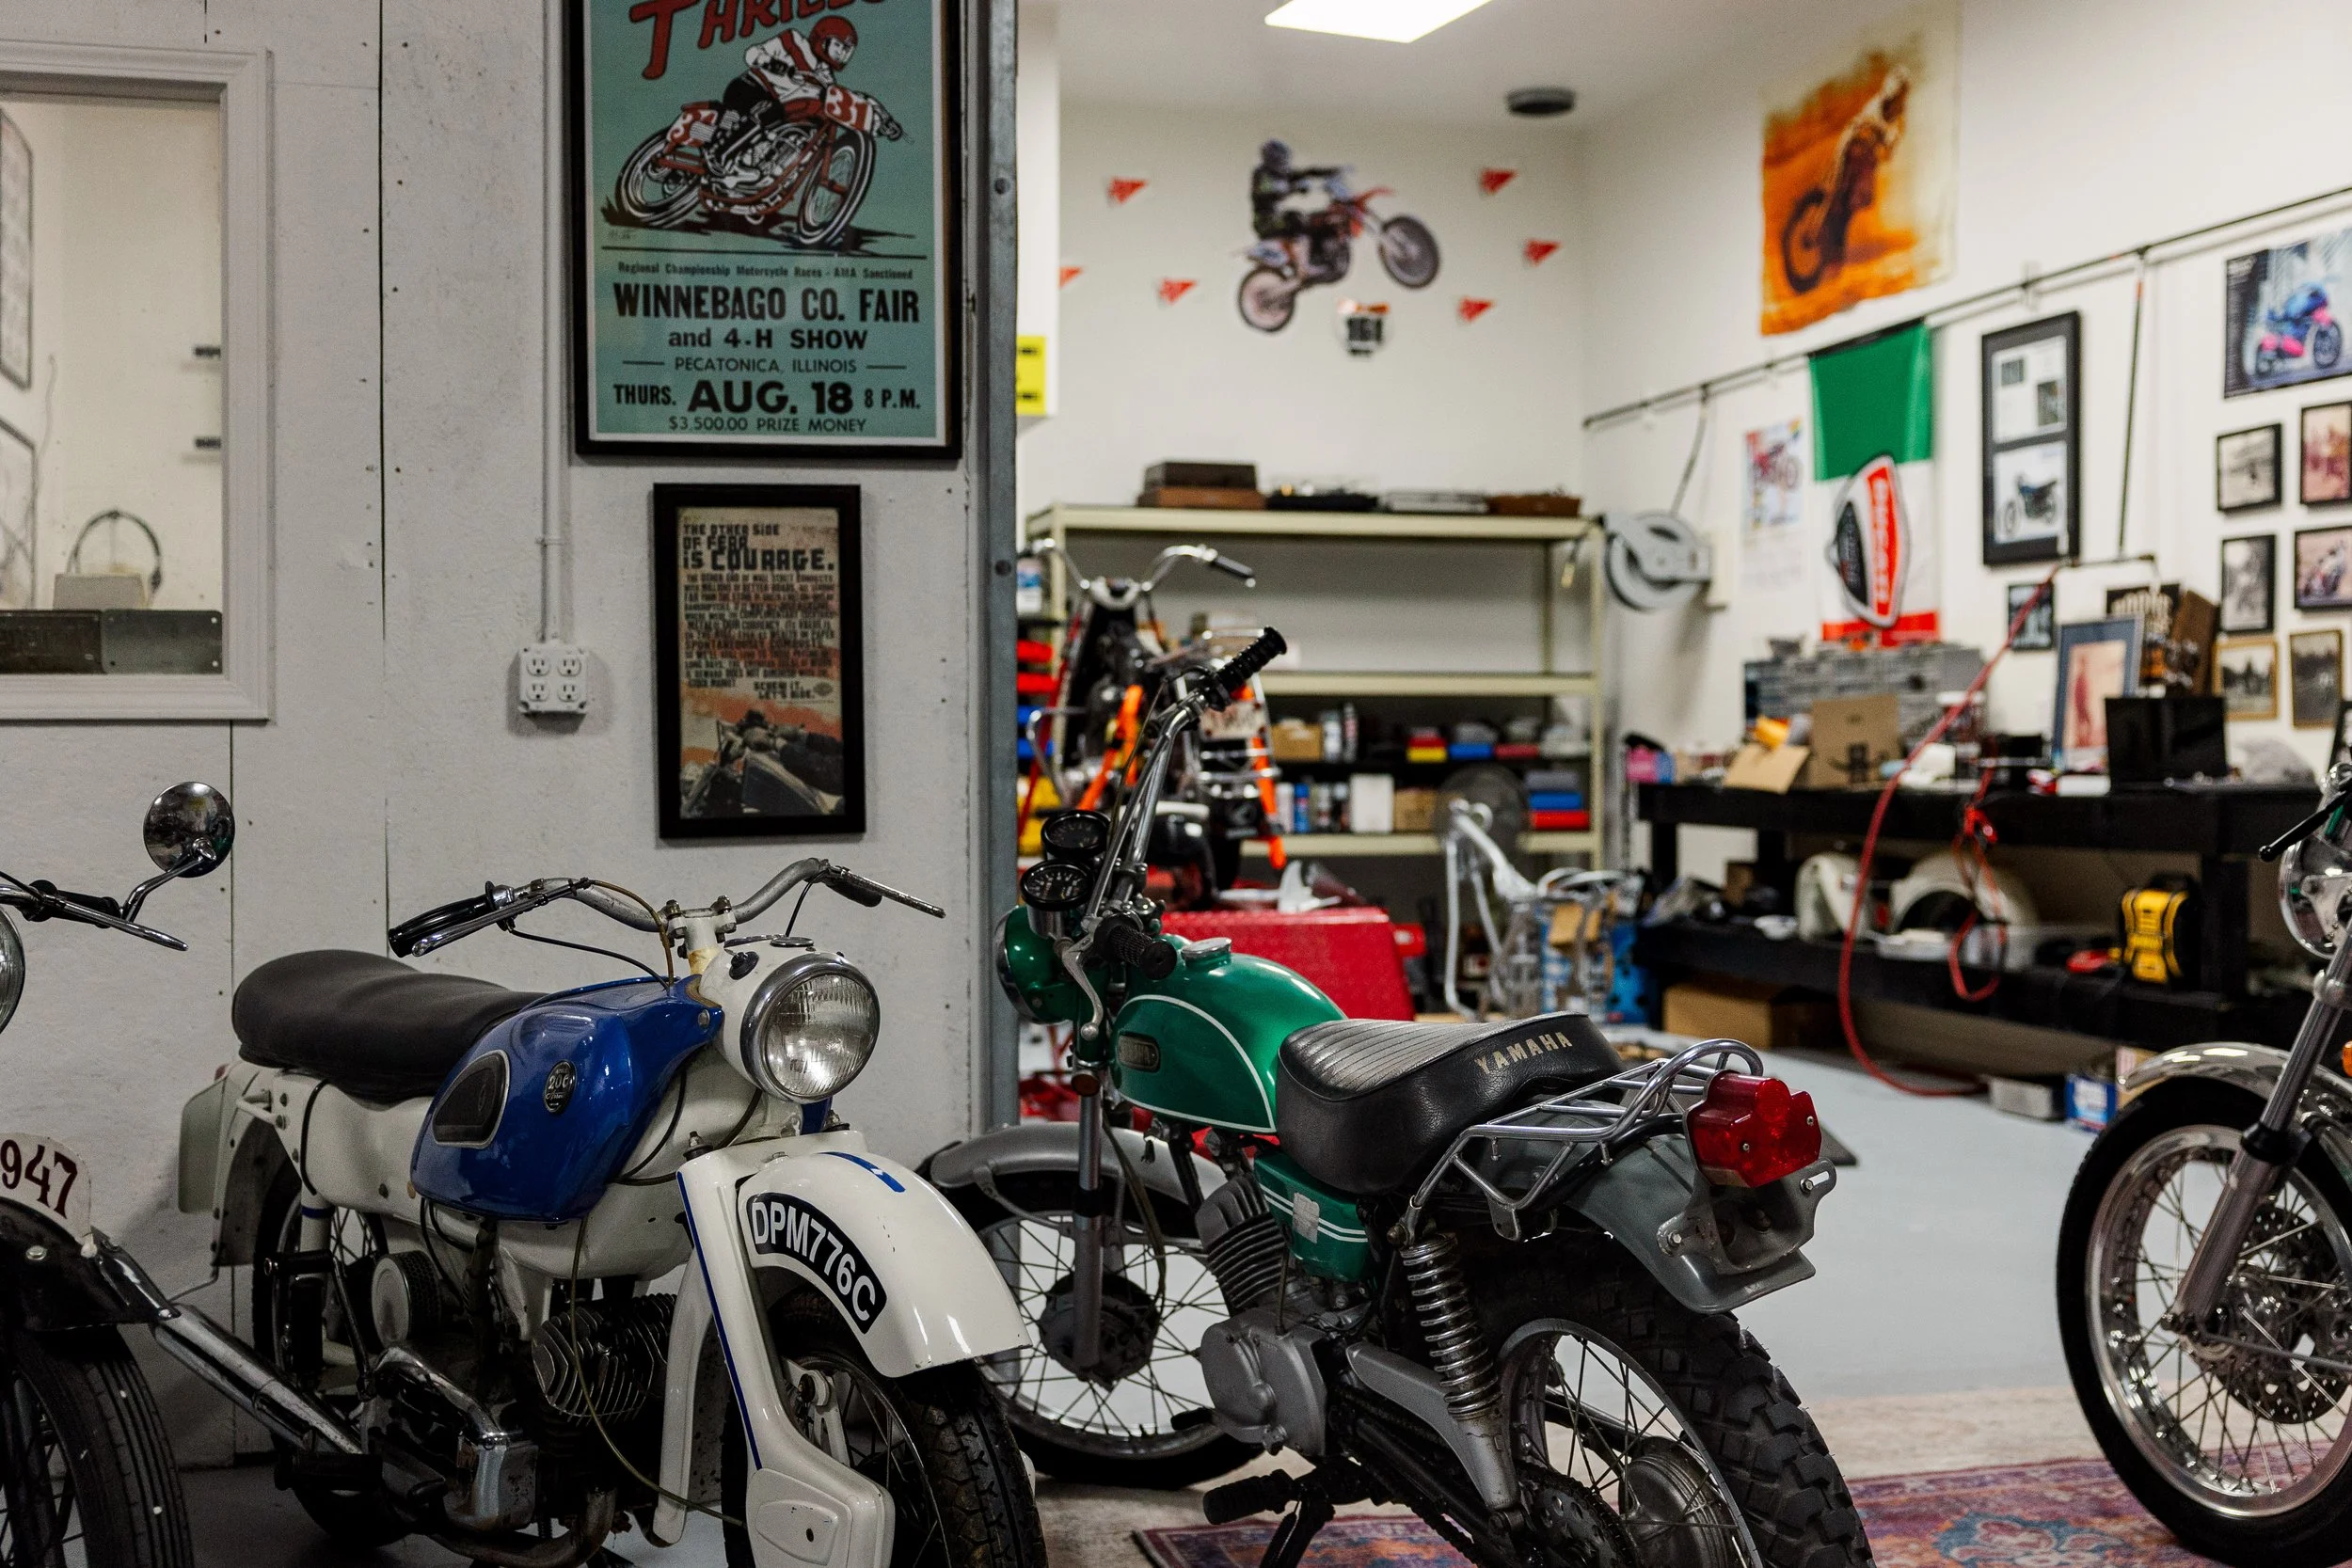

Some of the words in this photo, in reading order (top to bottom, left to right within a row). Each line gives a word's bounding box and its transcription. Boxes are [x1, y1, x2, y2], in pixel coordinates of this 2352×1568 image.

[827, 86, 867, 132] 31
[617, 261, 660, 275] Regional
[664, 262, 731, 277] Championship
[736, 264, 789, 277] Motorcycle
[793, 266, 823, 278] Races
[862, 267, 914, 280] Sanctioned
[612, 281, 787, 321] WINNEBAGO
[801, 287, 846, 322] CO.
[859, 288, 920, 324] FAIR
[668, 327, 712, 348] and
[790, 328, 868, 350] SHOW
[674, 356, 786, 374] PECATONICA,
[792, 358, 857, 374] ILLINOIS
[612, 384, 676, 406] THURS.
[687, 379, 798, 415] AUG.
[810, 381, 854, 415] 18
[864, 388, 874, 409] 8
[881, 388, 921, 409] P.M.
[756, 417, 800, 433] PRIZE
[807, 418, 866, 433] MONEY
[683, 524, 706, 535] THE
[710, 524, 749, 536] OTHER
[683, 536, 703, 549] OF
[707, 535, 749, 550] FEAR
[710, 548, 834, 570] COURAGE.
[1473, 1031, 1573, 1074] YAMAHA
[0, 1139, 78, 1219] 947
[752, 1201, 876, 1322] DPM776C
